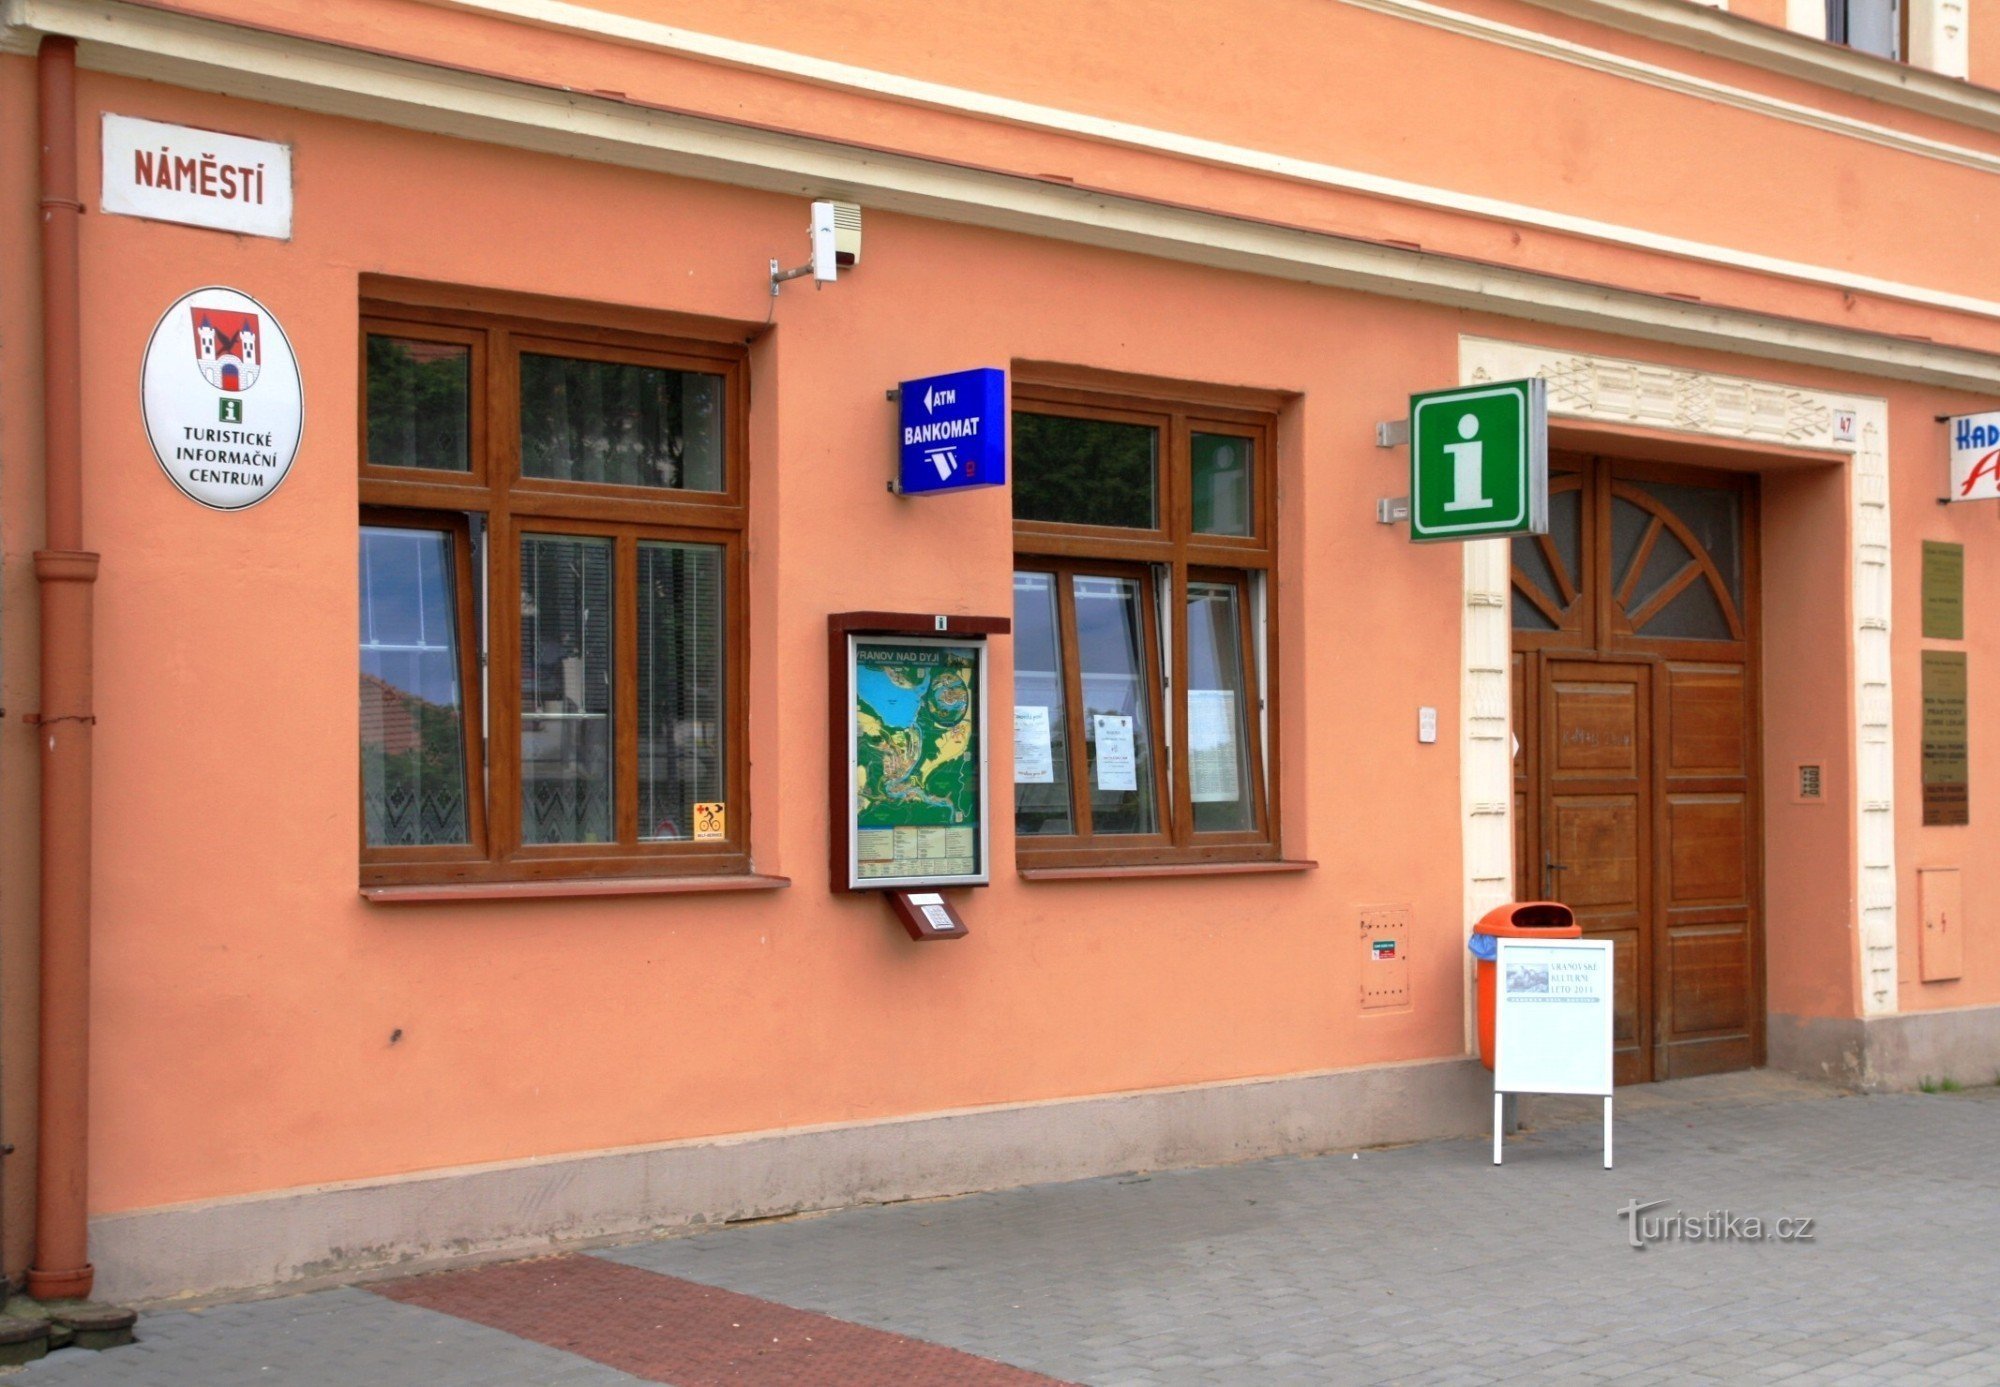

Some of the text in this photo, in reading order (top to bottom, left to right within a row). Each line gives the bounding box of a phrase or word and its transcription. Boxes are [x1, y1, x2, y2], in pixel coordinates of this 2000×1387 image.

[135, 146, 264, 205] NÁMĚSTÍ
[933, 389, 956, 407] ATM
[904, 417, 980, 446] BANKOMAT
[1840, 417, 1852, 433] 47
[184, 426, 272, 447] TURISTICKÉ
[177, 446, 277, 468] INFORMAČNÍ
[190, 468, 264, 487] CENTRUM
[896, 652, 917, 661] NAD
